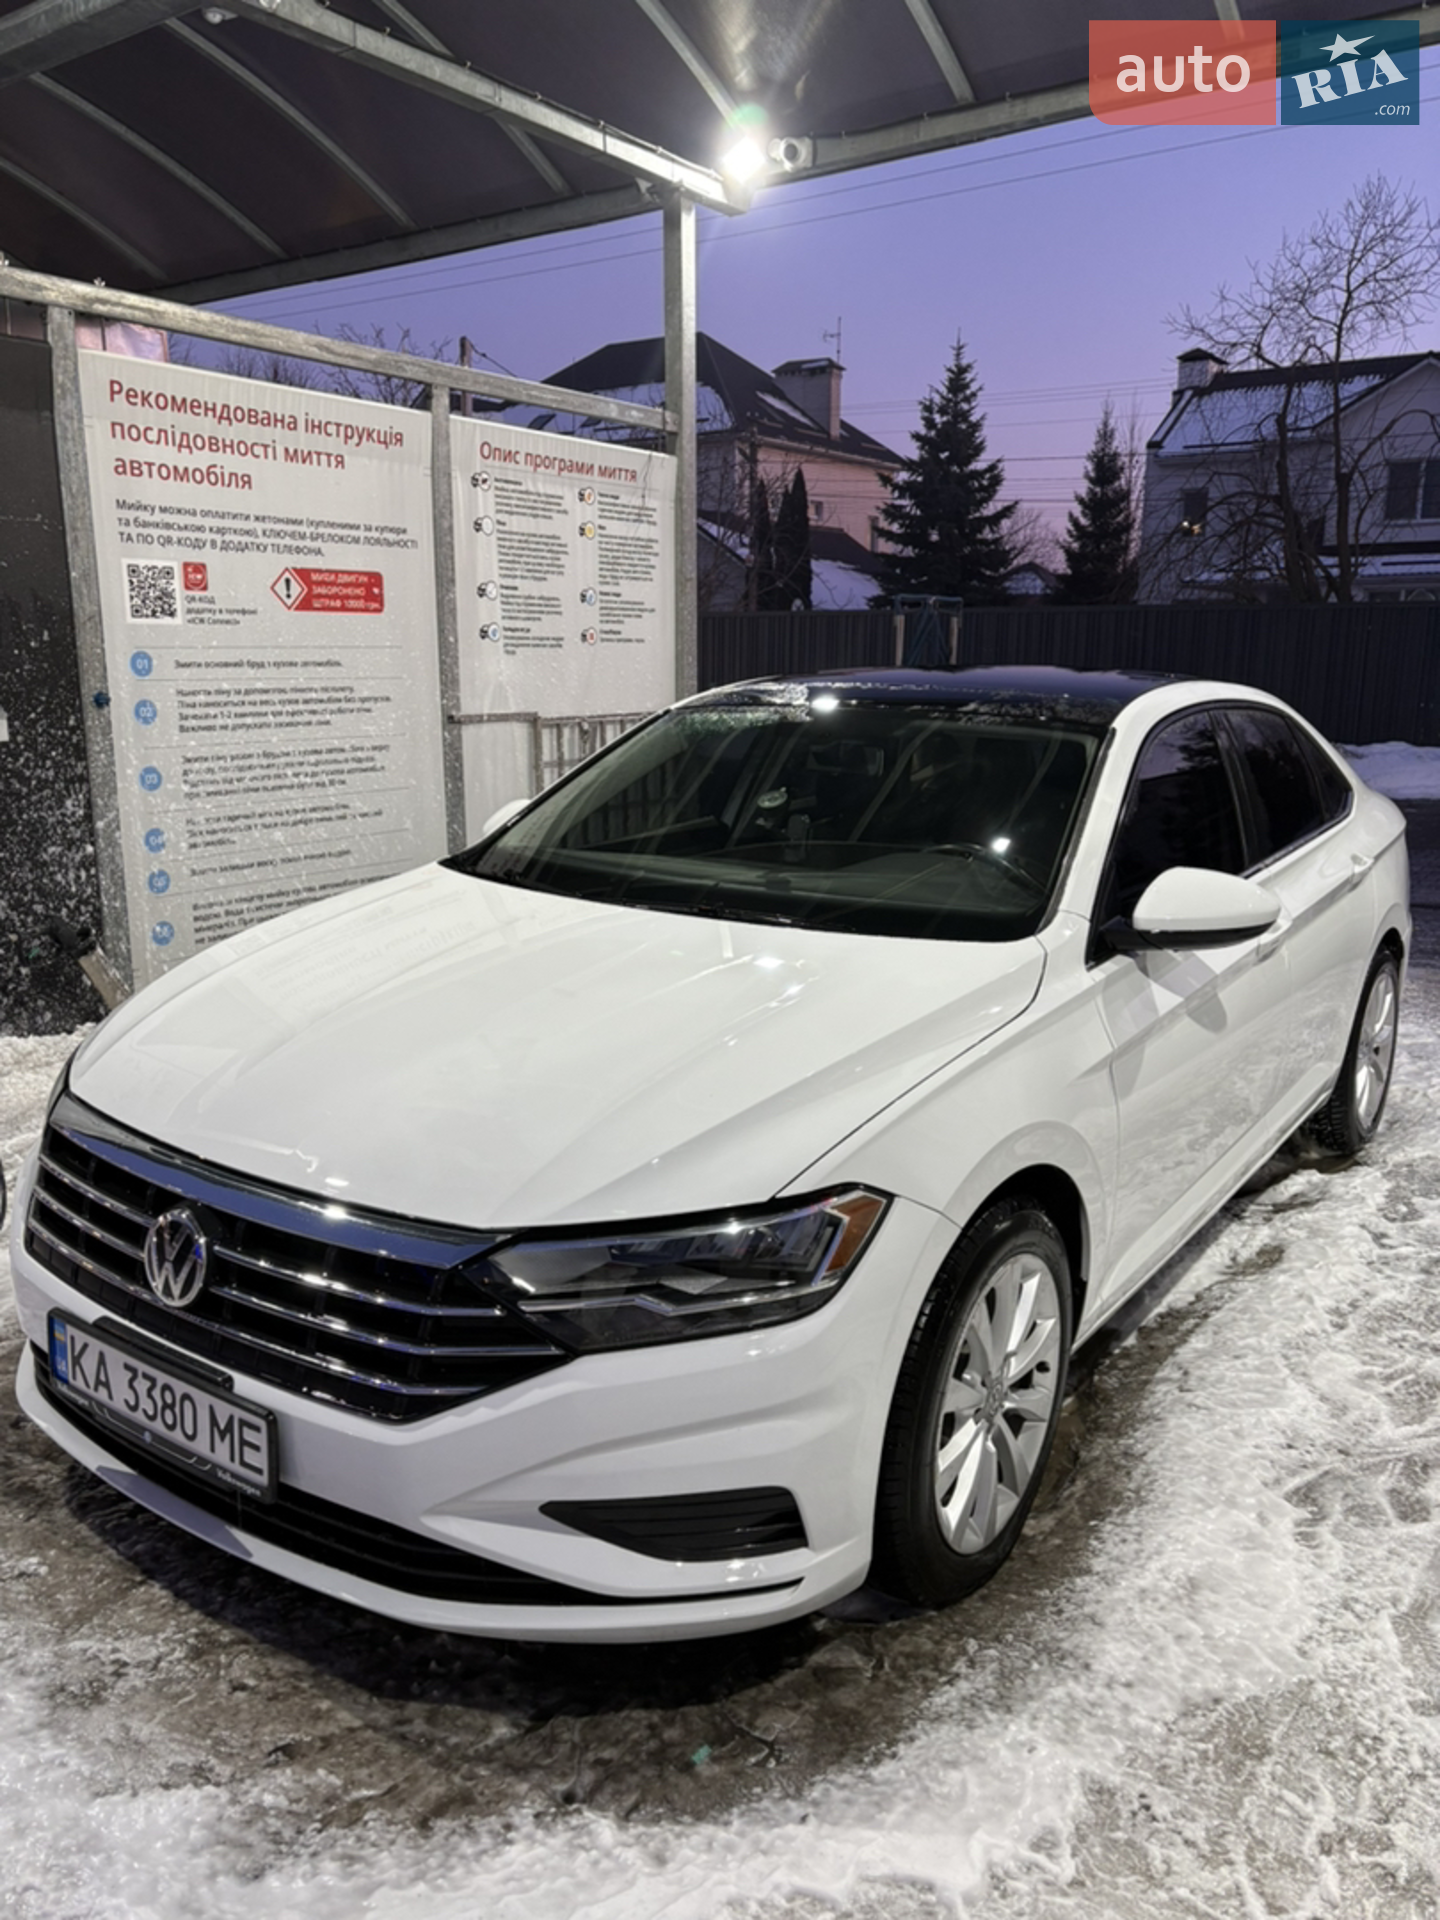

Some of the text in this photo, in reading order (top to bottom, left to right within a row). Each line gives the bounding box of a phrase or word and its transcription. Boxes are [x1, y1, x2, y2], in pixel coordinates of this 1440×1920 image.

[109, 379, 404, 447] Рекомендована інструкція
[110, 422, 346, 469] послідовності миття
[479, 441, 638, 482] Опис програми миття
[114, 457, 253, 490] автомобіля
[115, 499, 156, 516] Мийку
[159, 504, 197, 517] можна
[200, 509, 251, 522] оплатити
[117, 517, 130, 528] та
[133, 516, 207, 533] банківською
[118, 532, 134, 544] ТА
[136, 533, 154, 545] ПО
[157, 535, 208, 550] QR-КОДУ
[210, 540, 218, 550] В
[219, 540, 269, 553] ДОДАТКУ
[136, 658, 149, 670] 01
[70, 1334, 264, 1477] KA 3380 ME
